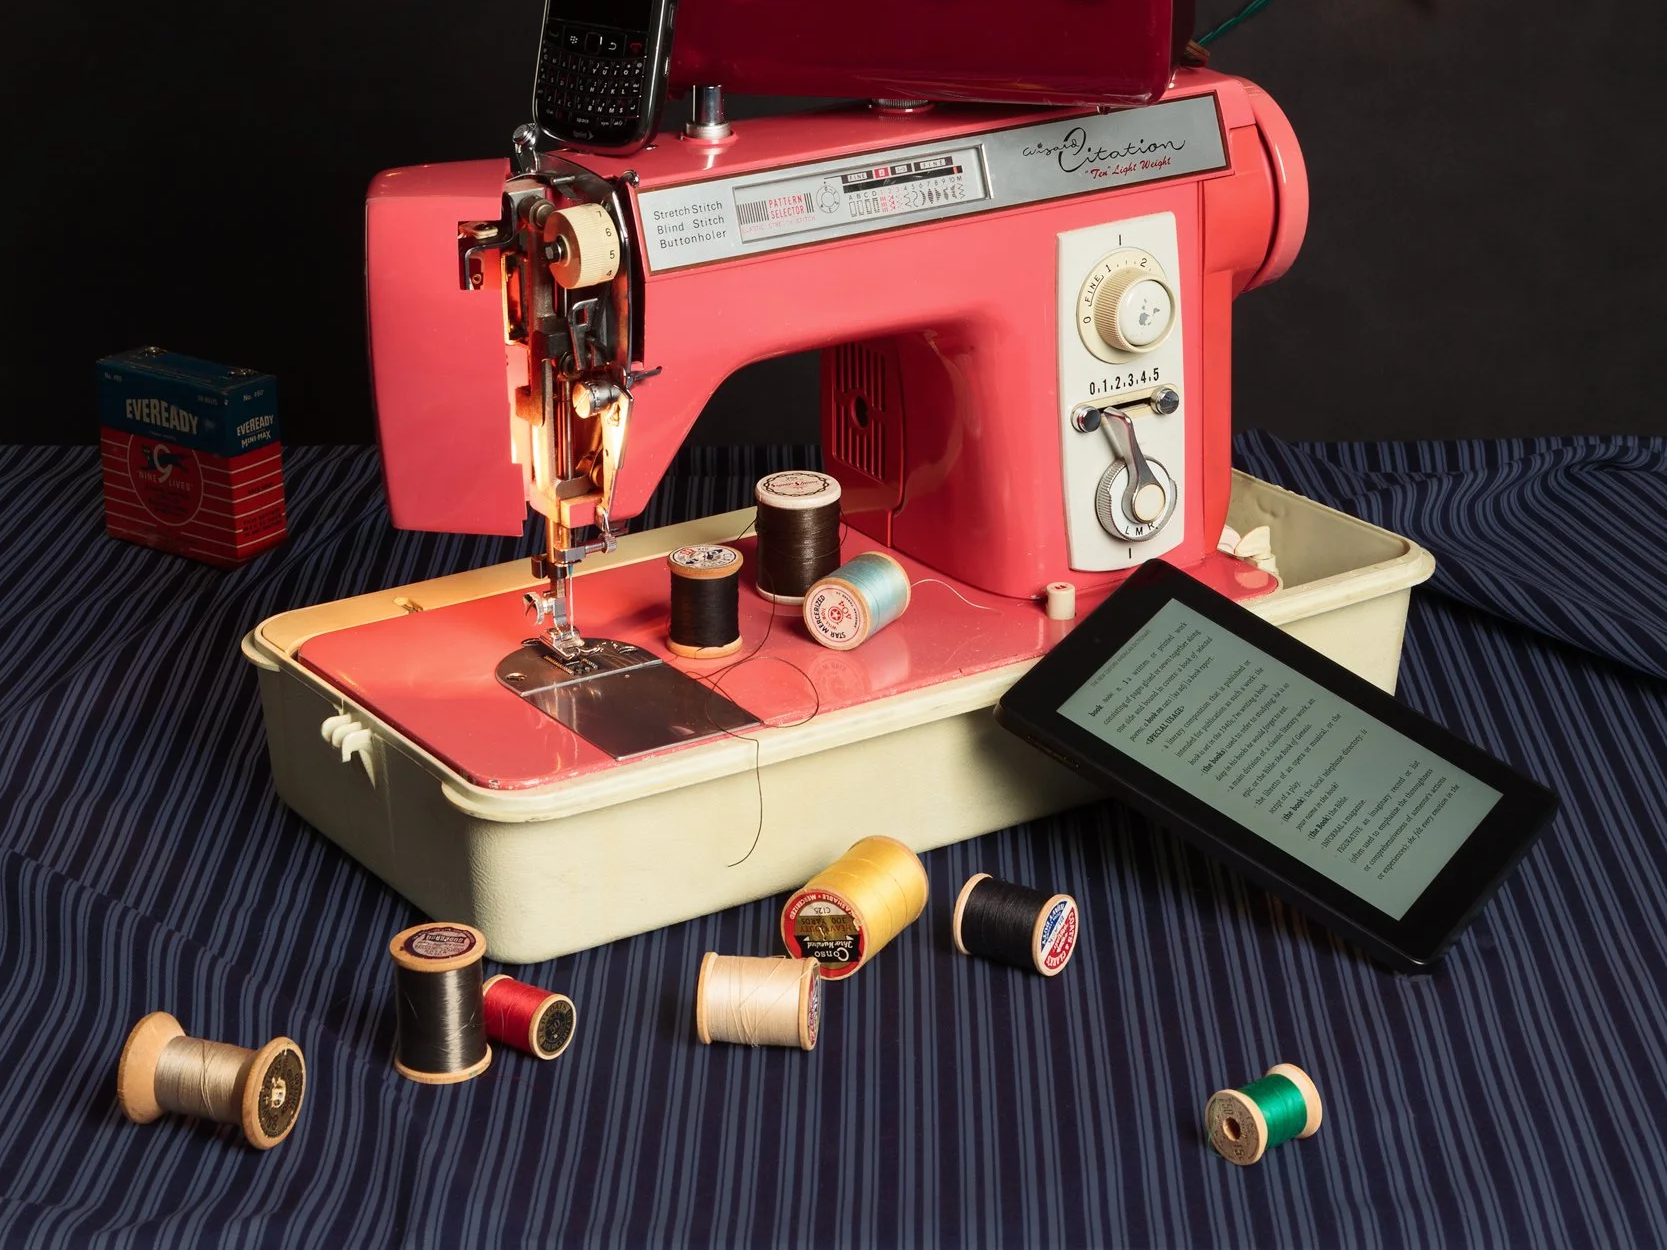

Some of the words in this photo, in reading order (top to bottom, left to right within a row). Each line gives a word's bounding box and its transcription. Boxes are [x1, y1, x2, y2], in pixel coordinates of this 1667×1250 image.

[1058, 126, 1186, 173] Citation
[1111, 161, 1137, 177] Light
[1139, 156, 1171, 172] Weight
[653, 206, 691, 221] Stretch
[691, 200, 723, 214] Stitch
[768, 195, 803, 208] PATTERN
[770, 205, 805, 220] SELECTOR
[605, 228, 611, 237] 6
[657, 224, 684, 235] Blind
[692, 215, 725, 229] Stitch
[659, 229, 727, 249] Buttonholer
[609, 250, 615, 259] 5
[1084, 275, 1102, 303] FINE
[1105, 264, 1112, 273] 1
[1140, 258, 1147, 268] 2
[126, 398, 199, 435] EVEREADY
[236, 414, 274, 437] EVEREADY
[153, 443, 173, 483] 9
[813, 594, 830, 634] MERCERIZED
[829, 630, 846, 639] STAR
[1335, 824, 1363, 854] FIGURATIVE
[1366, 793, 1394, 817] imaginary
[1389, 775, 1406, 793] record
[1408, 759, 1420, 769] list
[789, 894, 817, 920] MERCERIZED
[814, 947, 850, 962] Conso
